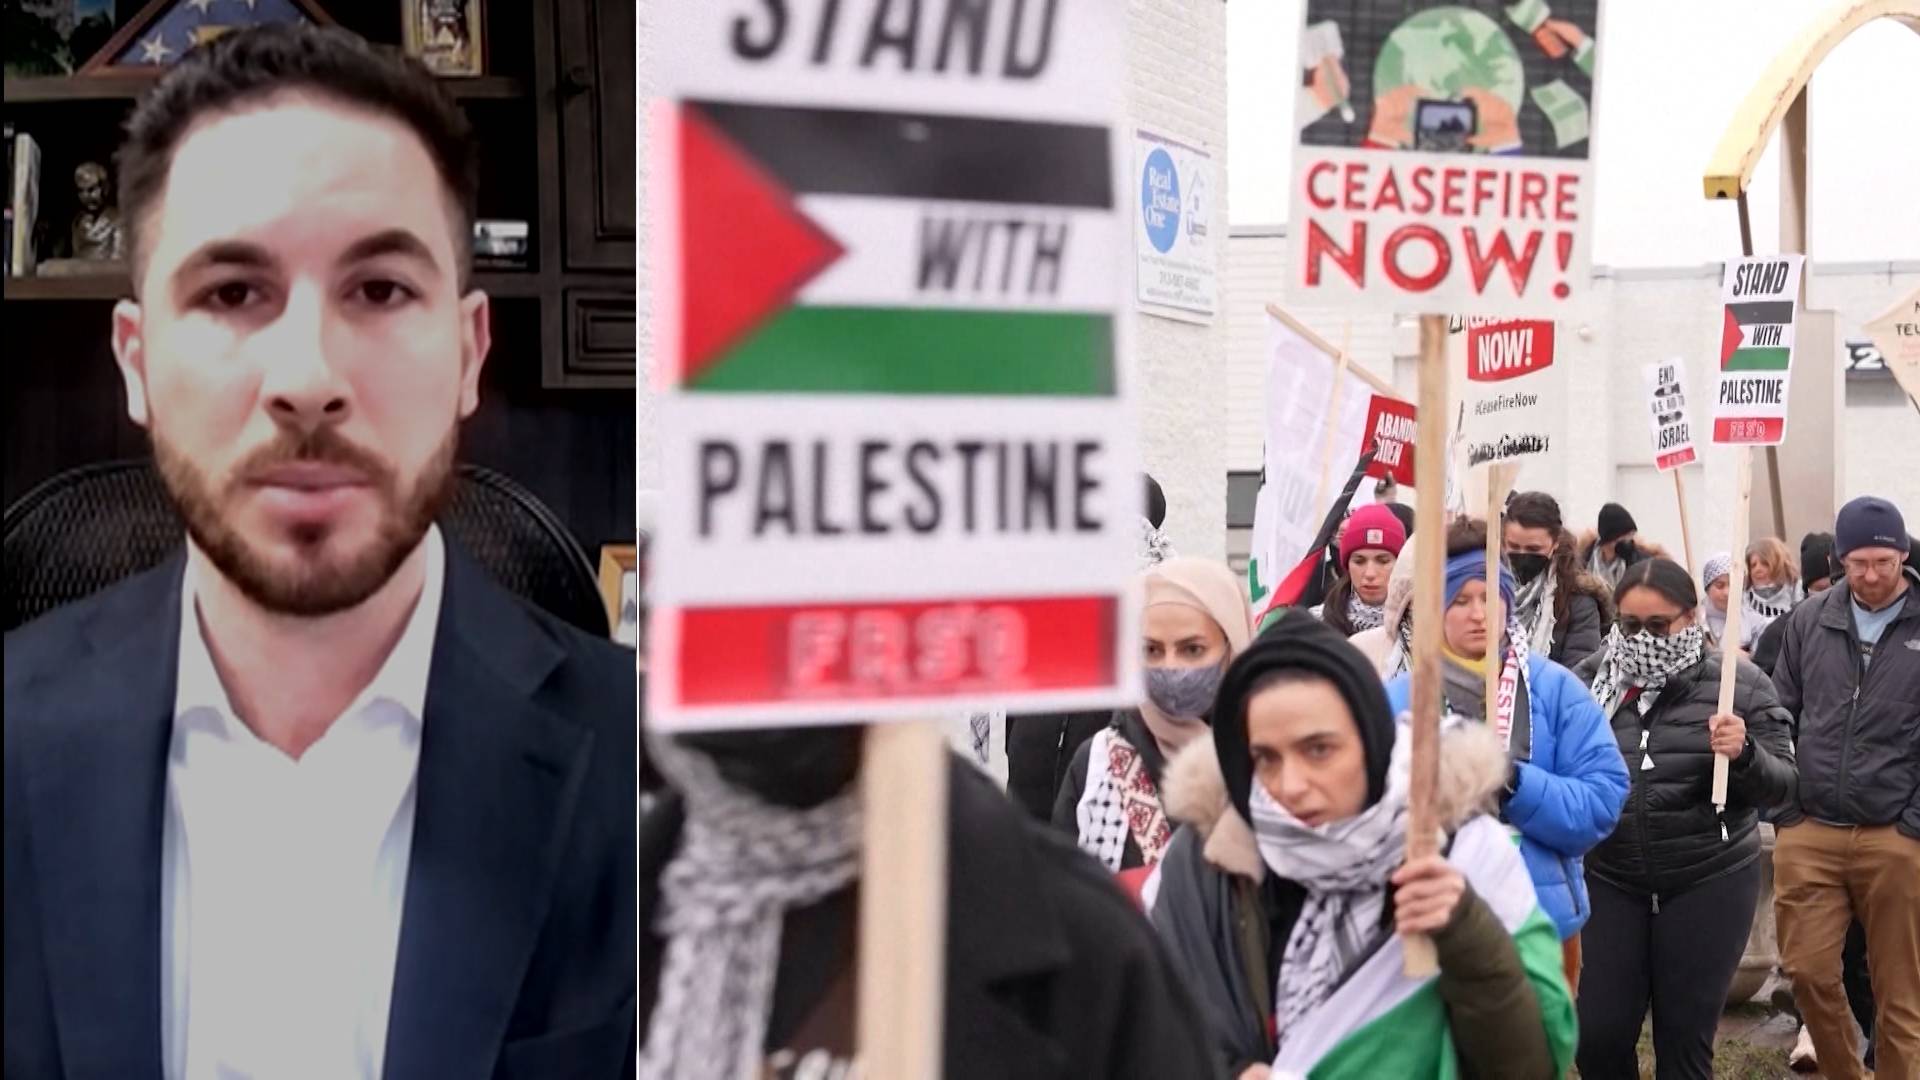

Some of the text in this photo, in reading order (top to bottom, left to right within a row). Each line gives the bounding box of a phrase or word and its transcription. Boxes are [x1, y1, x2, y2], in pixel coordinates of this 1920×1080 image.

[1149, 167, 1171, 191] Real
[1306, 161, 1580, 221] CEASEFIRE
[1145, 206, 1166, 228] One
[916, 217, 1069, 293] WITH
[1304, 218, 1574, 299] NOW!
[1733, 262, 1789, 296] STAND
[1478, 327, 1533, 374] NOW!
[1752, 325, 1782, 346] WITH
[1659, 365, 1675, 386] END
[1720, 379, 1783, 404] PALESTINE
[1658, 423, 1690, 451] ISRAEL
[699, 439, 1104, 536] PALESTINE
